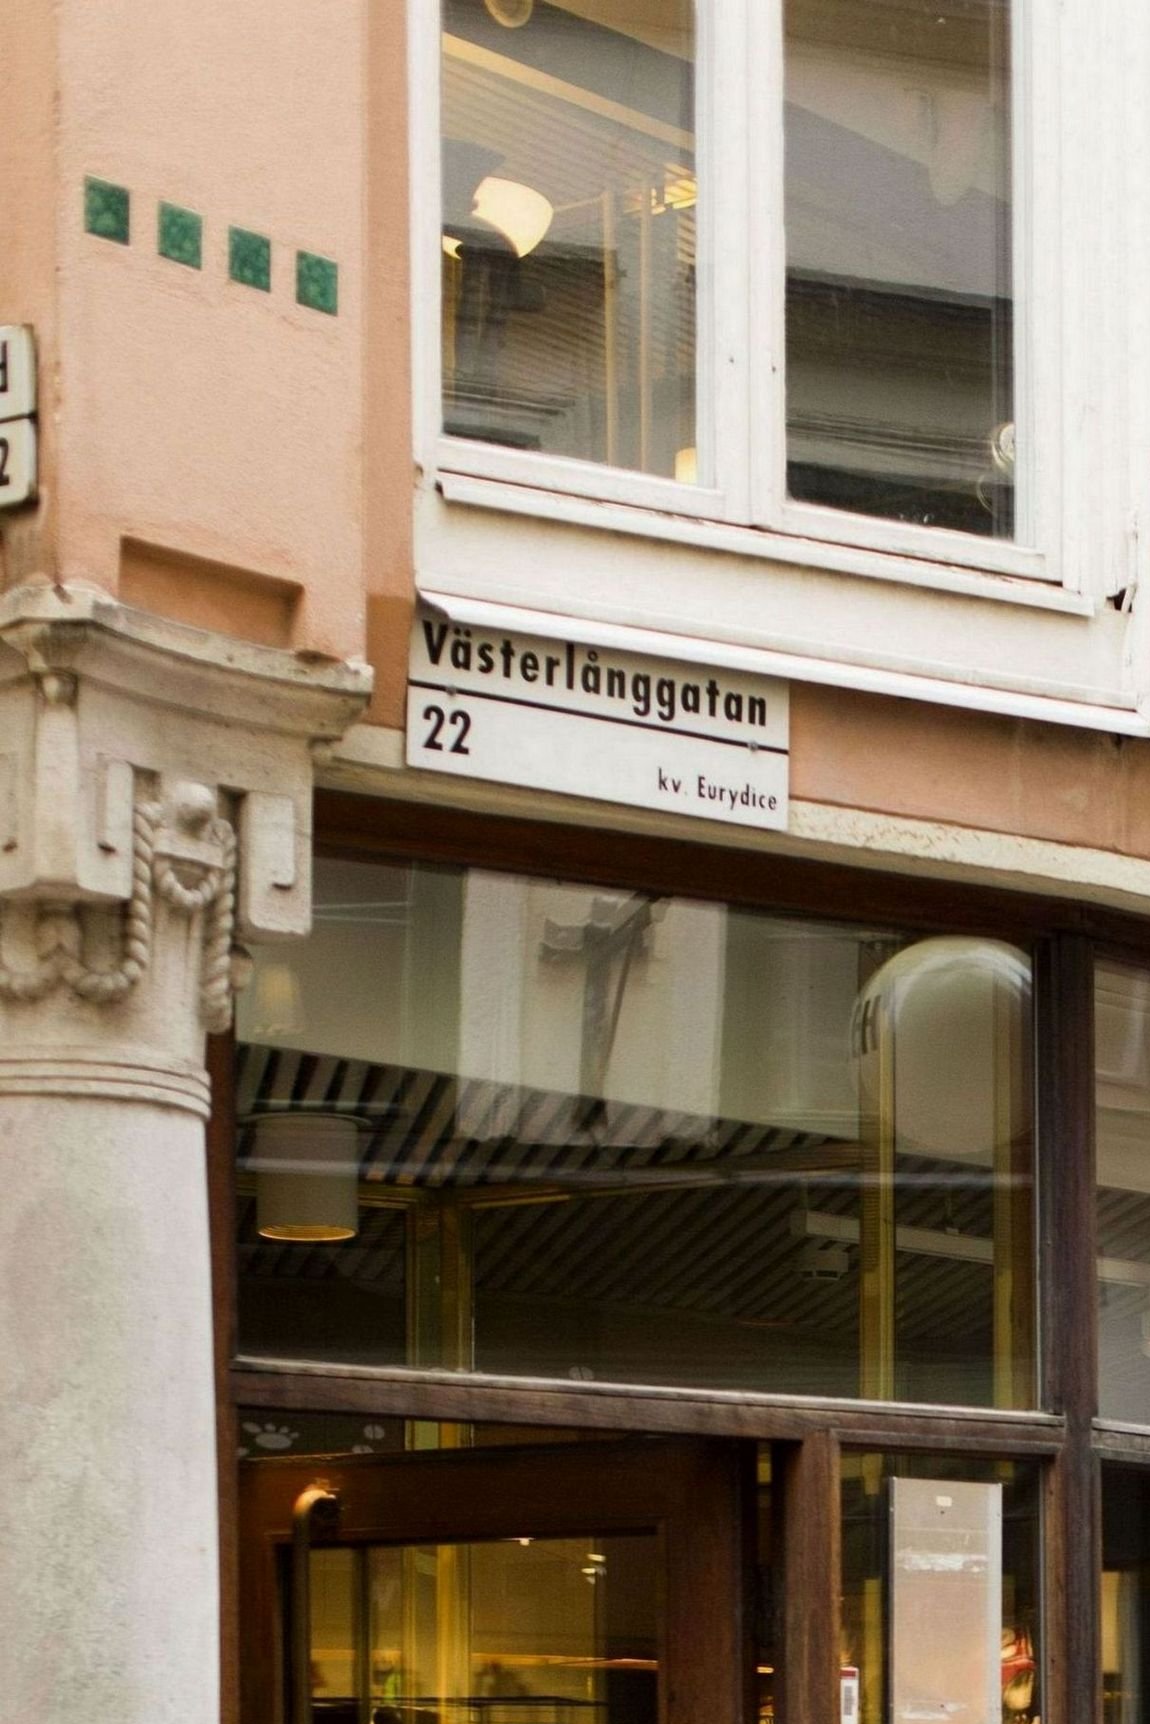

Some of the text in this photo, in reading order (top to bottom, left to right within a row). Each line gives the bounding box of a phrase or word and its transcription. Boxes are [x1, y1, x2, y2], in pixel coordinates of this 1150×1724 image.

[421, 619, 768, 727] Västerlånggatan
[421, 704, 472, 755] 22
[697, 775, 778, 811] Eurydice
